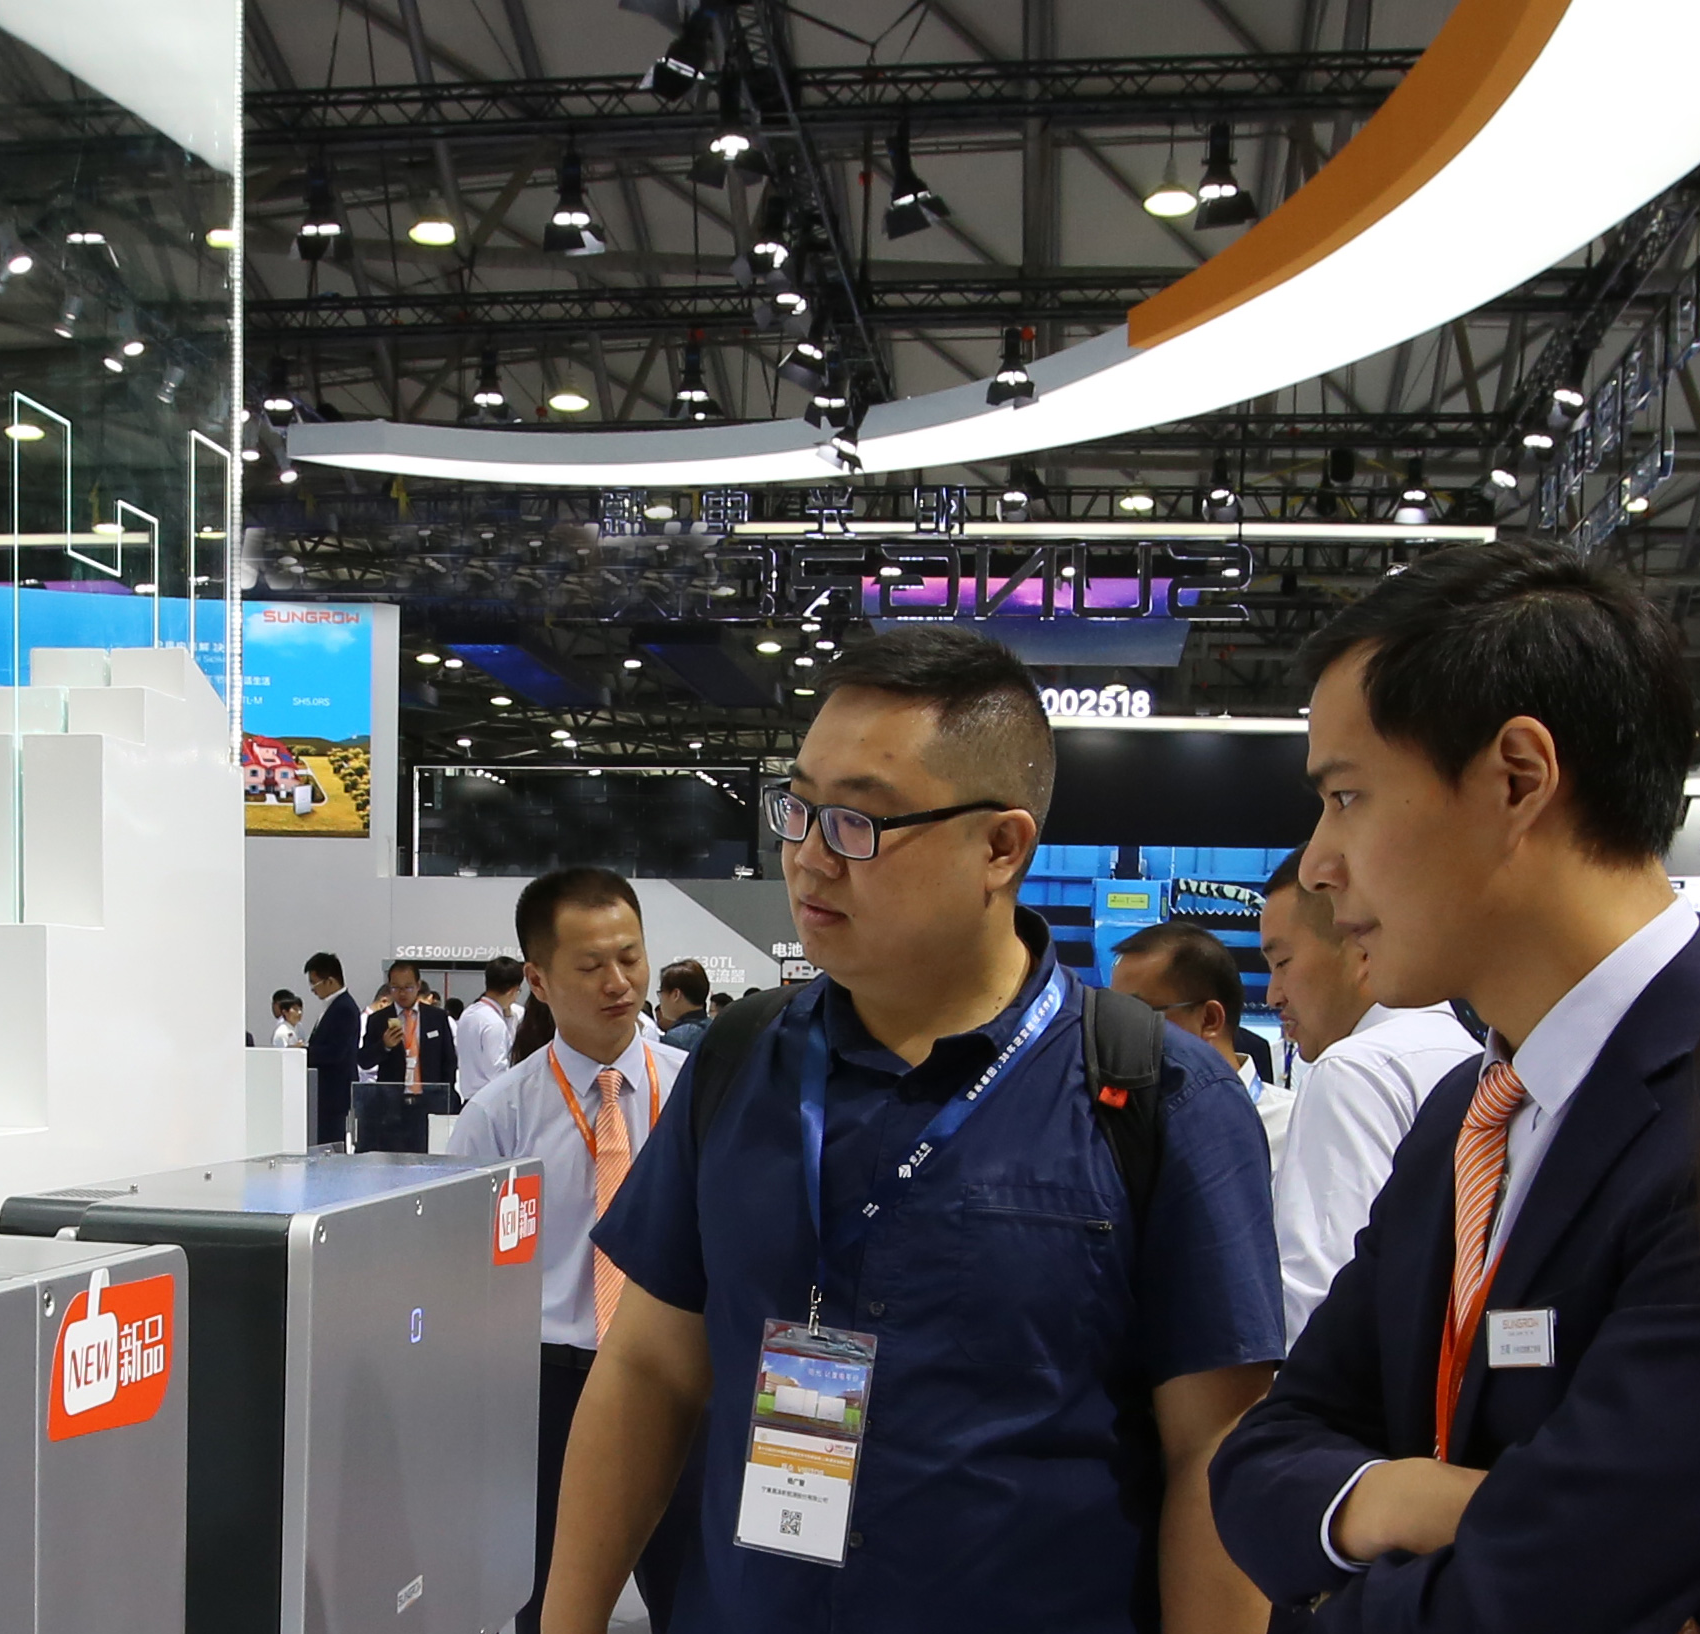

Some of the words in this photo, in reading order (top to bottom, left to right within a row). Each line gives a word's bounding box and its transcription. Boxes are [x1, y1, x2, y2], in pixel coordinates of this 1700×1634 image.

[263, 610, 360, 624] SUNGROW
[293, 697, 331, 707] SH5.0RS
[1041, 688, 1151, 718] 002518
[772, 942, 804, 958] 电池
[519, 1198, 536, 1240] 新品
[67, 1338, 113, 1392] NEW
[120, 1314, 165, 1387] 新品
